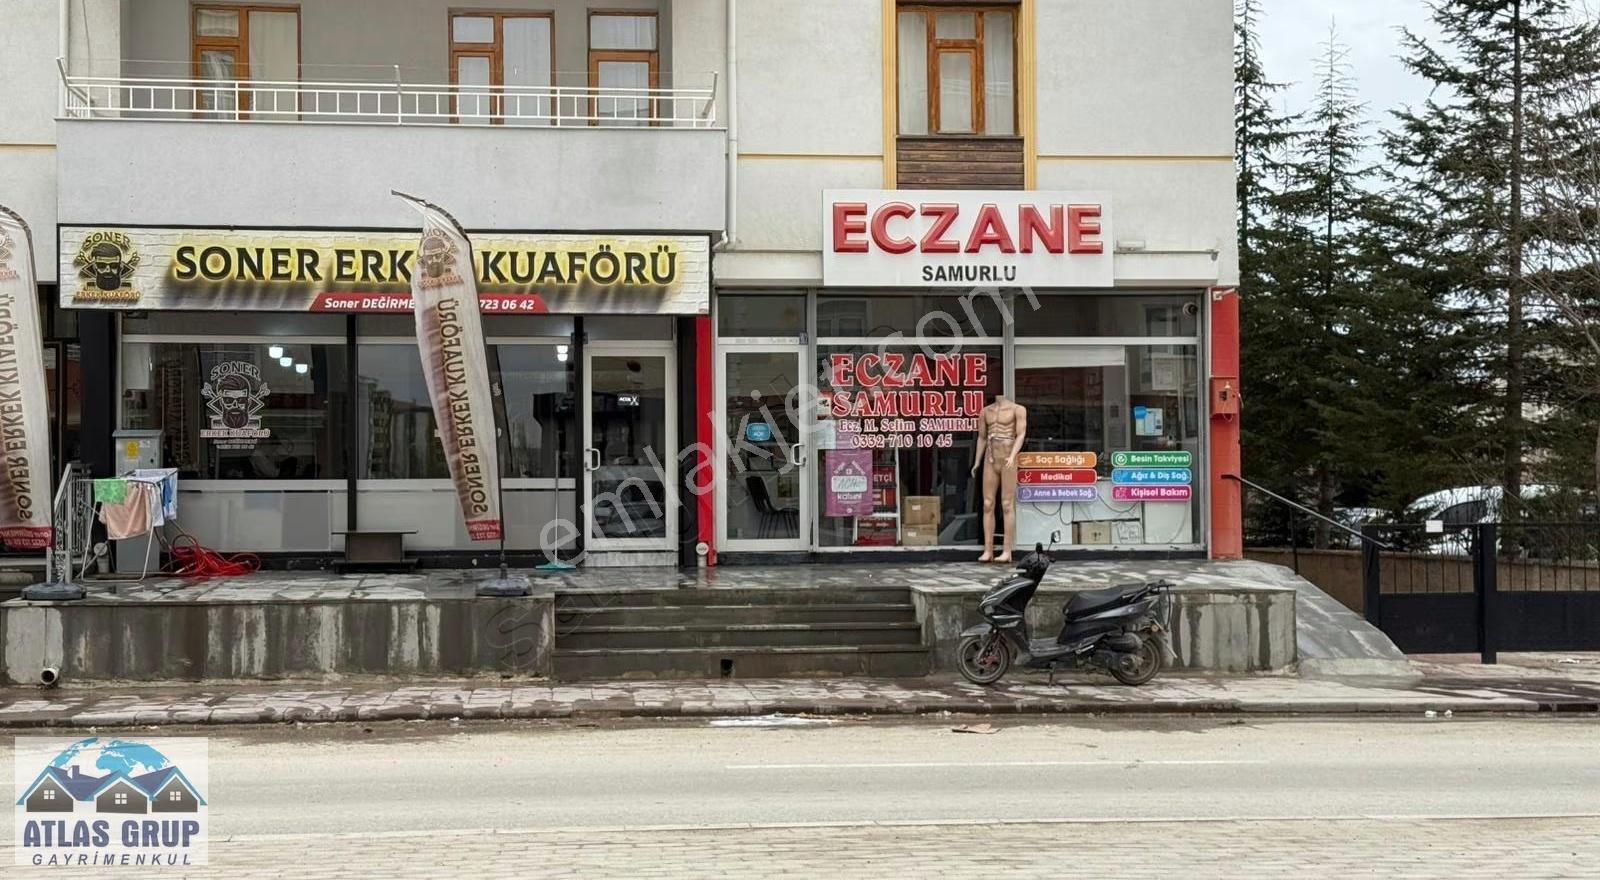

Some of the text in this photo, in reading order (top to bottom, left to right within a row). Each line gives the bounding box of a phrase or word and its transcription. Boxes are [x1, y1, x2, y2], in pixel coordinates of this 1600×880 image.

[832, 201, 1104, 254] ECZANE
[83, 231, 131, 250] SONER
[175, 245, 323, 282] SONER
[335, 249, 414, 283] ERK
[480, 244, 677, 285] KUAFÖRÜ
[922, 265, 1017, 282] SAMURLU
[324, 296, 416, 309] Soner DEĞİRME
[479, 299, 535, 310] 723 06 42
[210, 360, 262, 381] SONER
[830, 353, 987, 387] ECZANE
[832, 391, 985, 417] SAMURLU
[880, 418, 916, 432] Selim
[852, 433, 954, 448] 0332 710 10 45
[1035, 455, 1086, 466] Saç Sağlığı
[1131, 453, 1190, 465] Besin Takviyesi
[873, 472, 892, 482] ETÇİ
[1040, 471, 1073, 481] Medikal
[1131, 470, 1190, 481] Ağız & Diş Sağ.
[1034, 489, 1051, 497] Anne
[1058, 488, 1078, 497] Bebek
[1131, 486, 1188, 498] Kişisel Bakım
